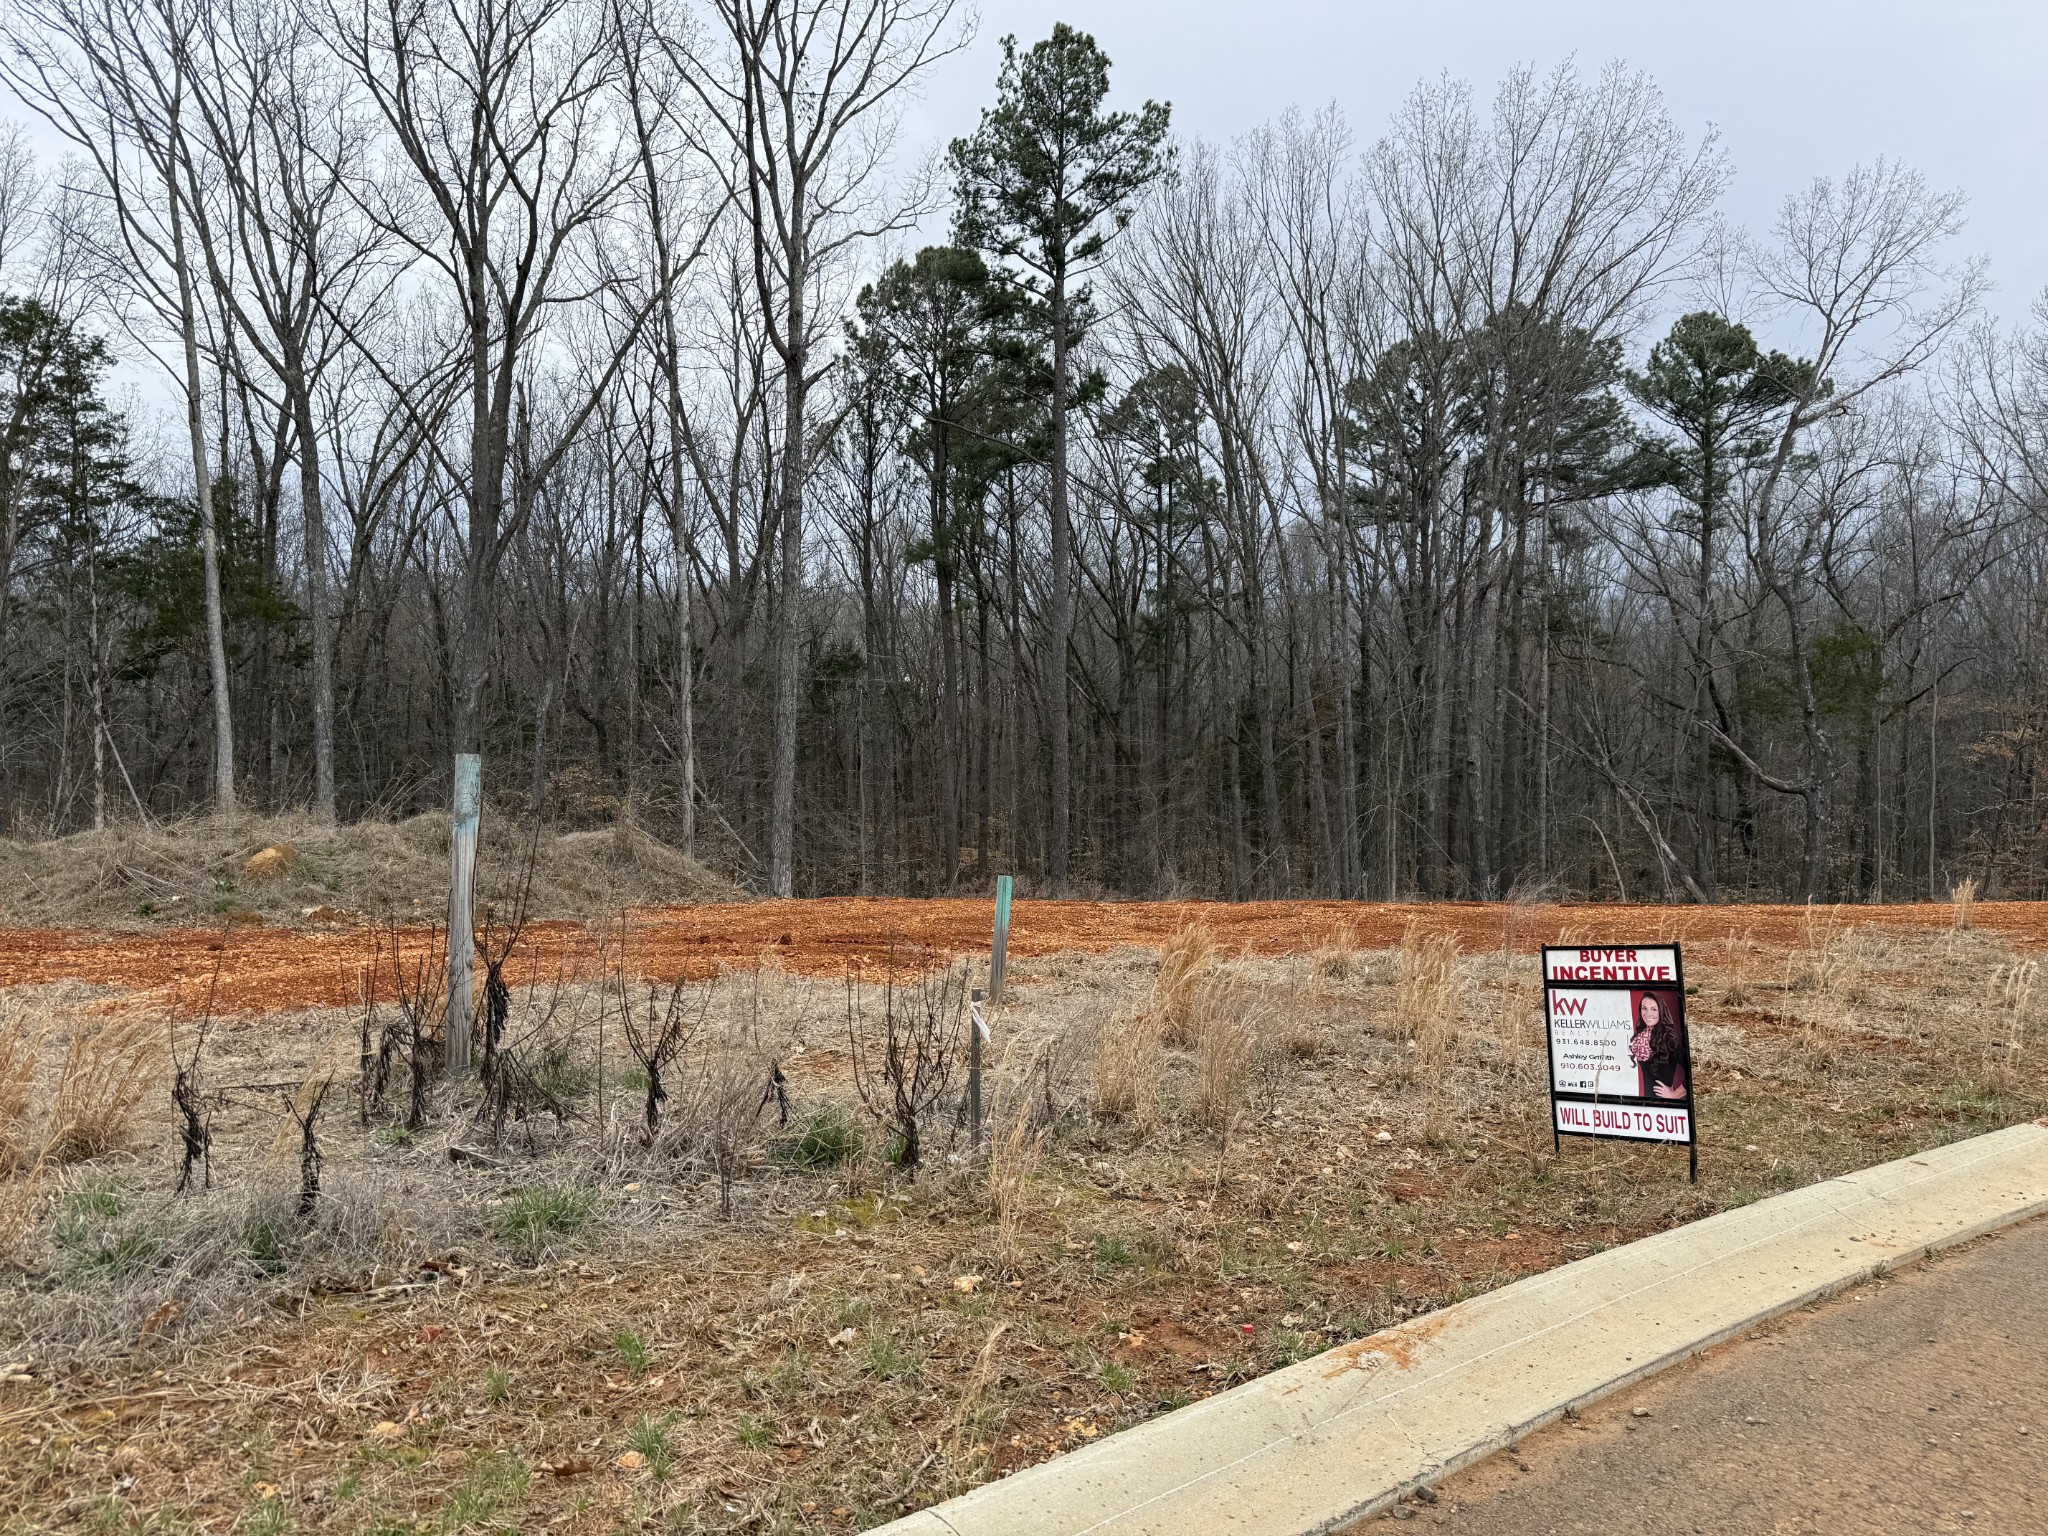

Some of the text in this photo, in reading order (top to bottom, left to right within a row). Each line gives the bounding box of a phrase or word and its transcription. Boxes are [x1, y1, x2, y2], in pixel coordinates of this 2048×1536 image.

[1580, 949, 1637, 962] BUYER
[1553, 966, 1670, 981] INCENTIVE
[1556, 1038, 1617, 1047] 931.648.8500
[1563, 1053, 1588, 1061] Ashley
[1560, 1062, 1621, 1072] 910.603.5049
[1560, 1106, 1686, 1134] WILL BUILD TO SUIT
